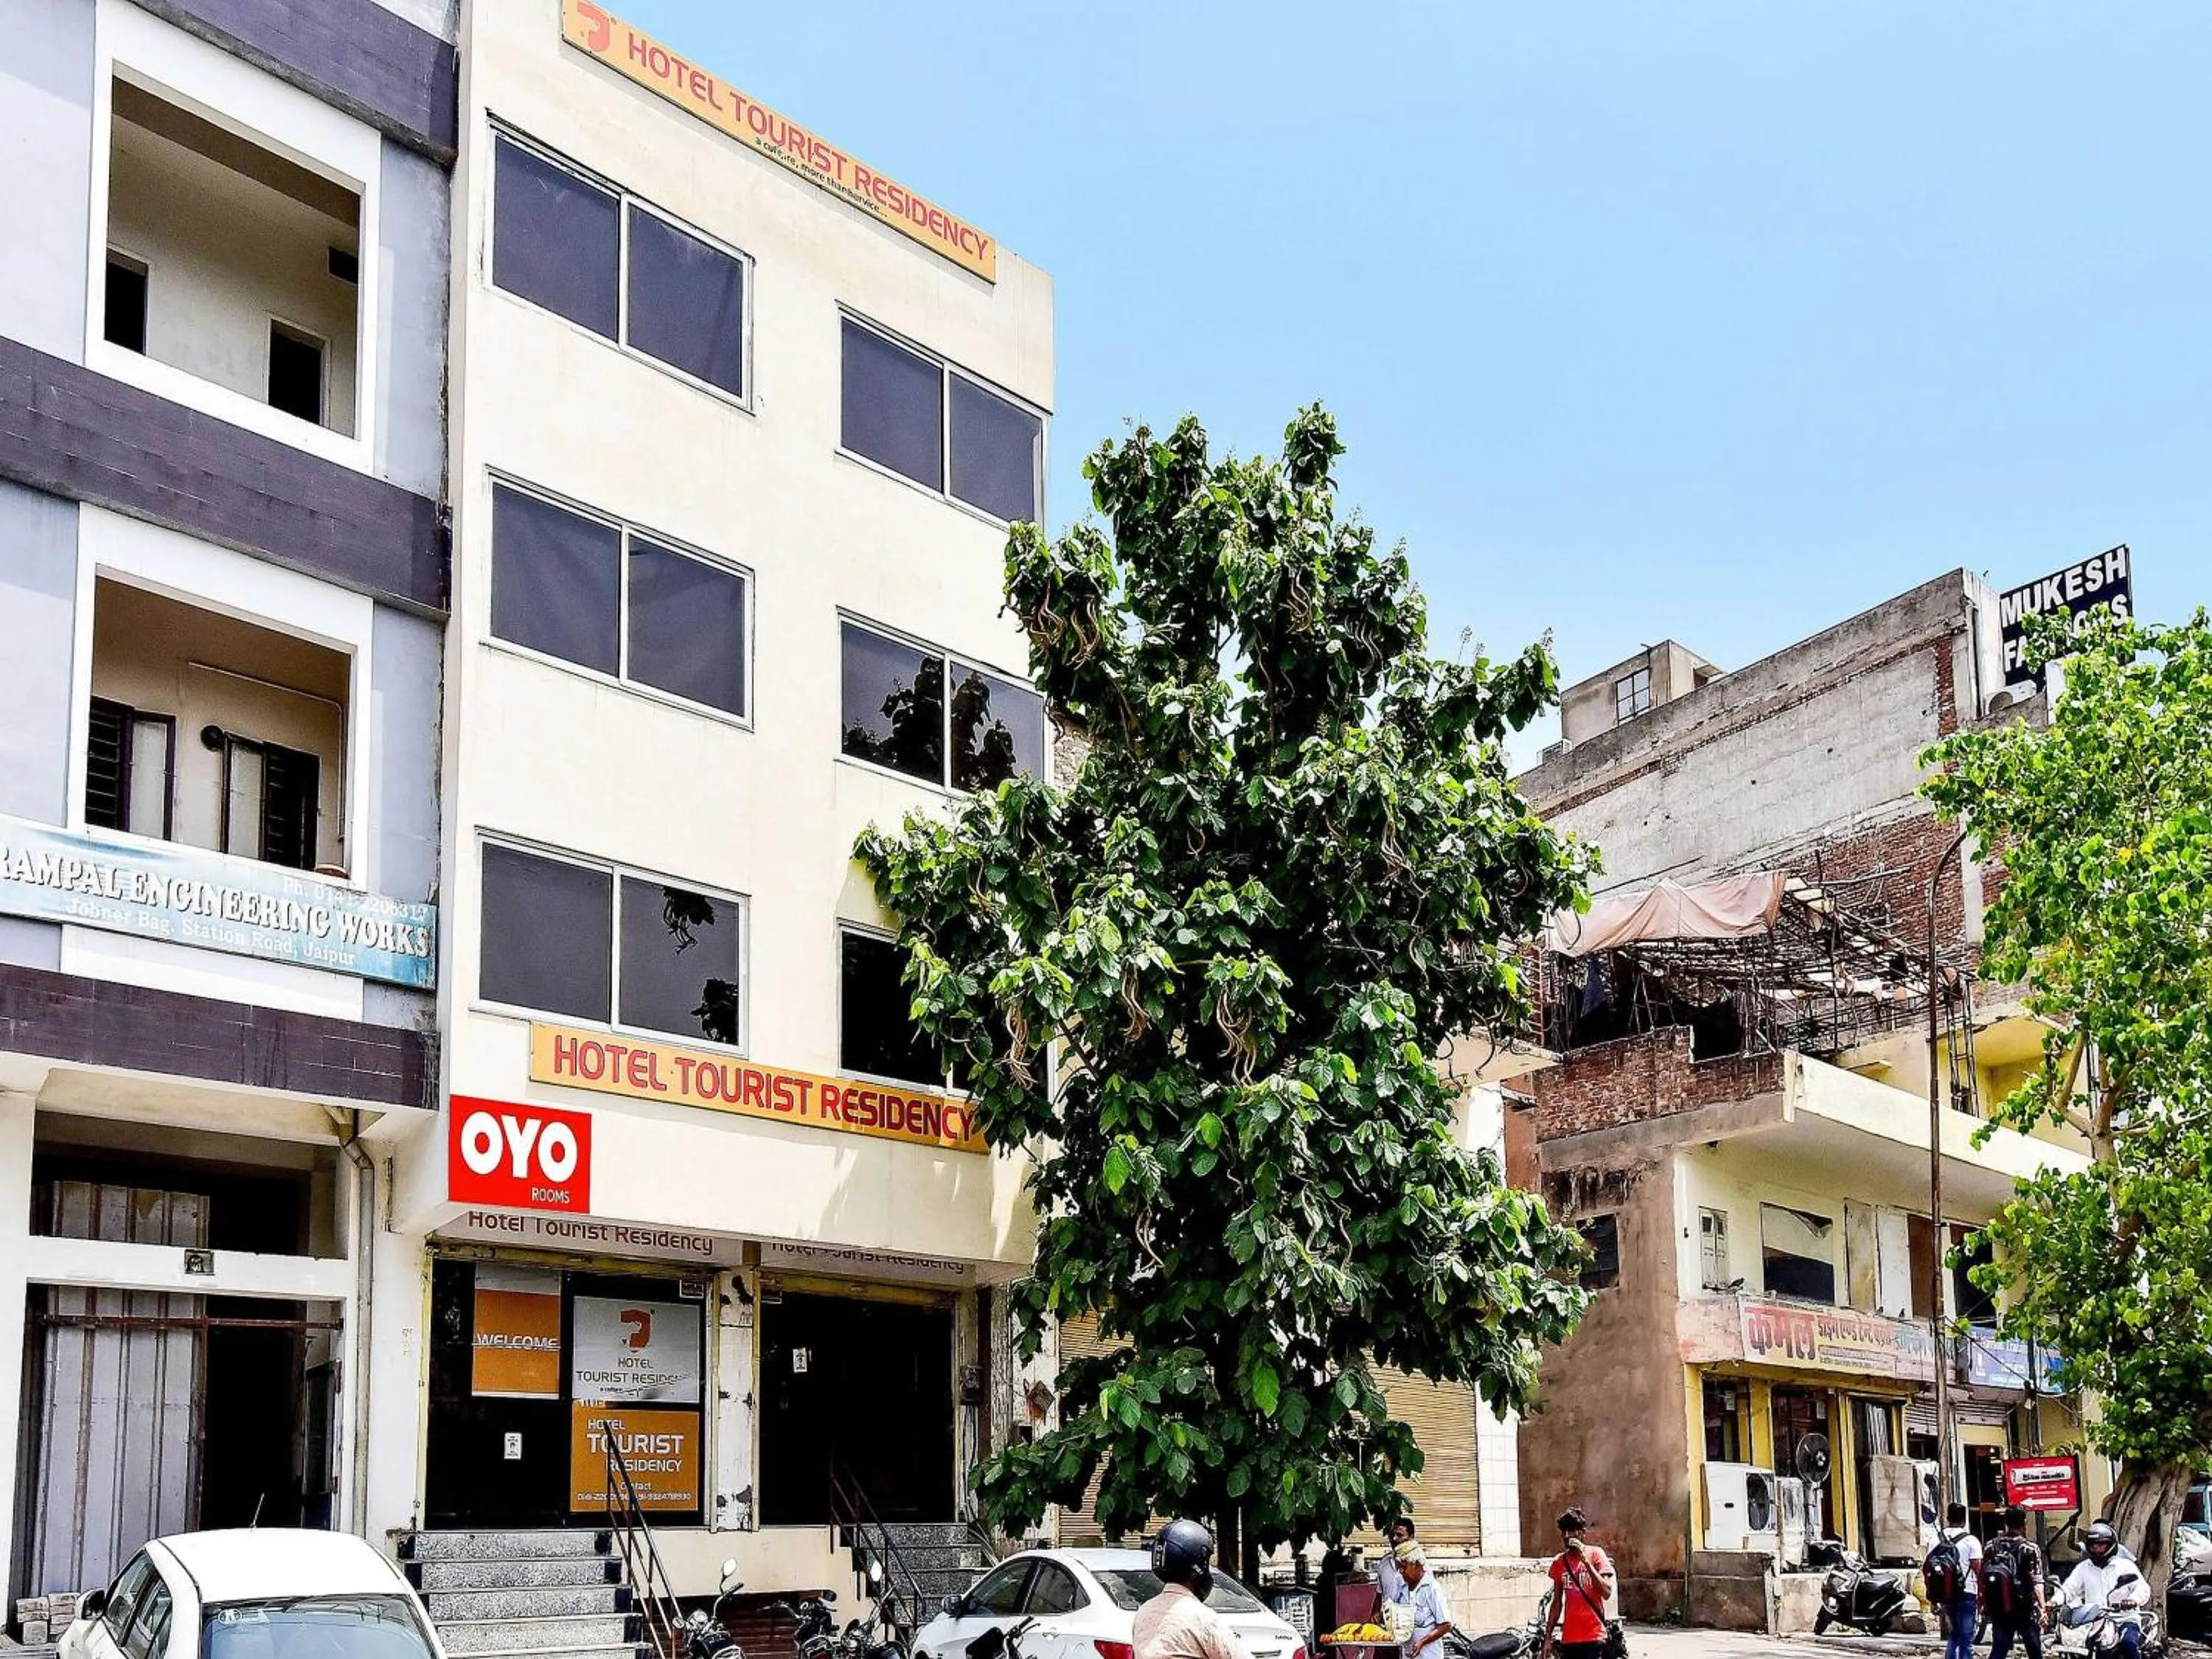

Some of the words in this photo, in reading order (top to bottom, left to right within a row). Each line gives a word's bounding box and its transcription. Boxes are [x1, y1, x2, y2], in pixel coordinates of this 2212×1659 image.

[628, 32, 723, 111] HOTEL
[729, 91, 848, 181] TOURIST
[855, 164, 988, 260] RESIDENCY
[801, 163, 825, 182] more
[2000, 546, 2127, 627] MUKESH
[129, 872, 331, 938] ENGINEERING
[335, 911, 431, 958] WORKS
[182, 919, 246, 946] Station
[251, 933, 297, 959] Road,
[304, 940, 356, 966] Jaipur
[554, 1034, 667, 1091] HOTEL
[675, 1057, 813, 1115] TOURIST
[821, 1083, 975, 1142] RESIDENCY
[461, 1111, 578, 1183] OYO
[532, 1186, 570, 1204] ROOMS
[467, 1210, 524, 1232] Hotel
[535, 1218, 608, 1242] Tourist
[615, 1226, 713, 1256] Residency
[576, 1371, 628, 1383] TOURIST
[618, 1357, 653, 1369] HOTEL
